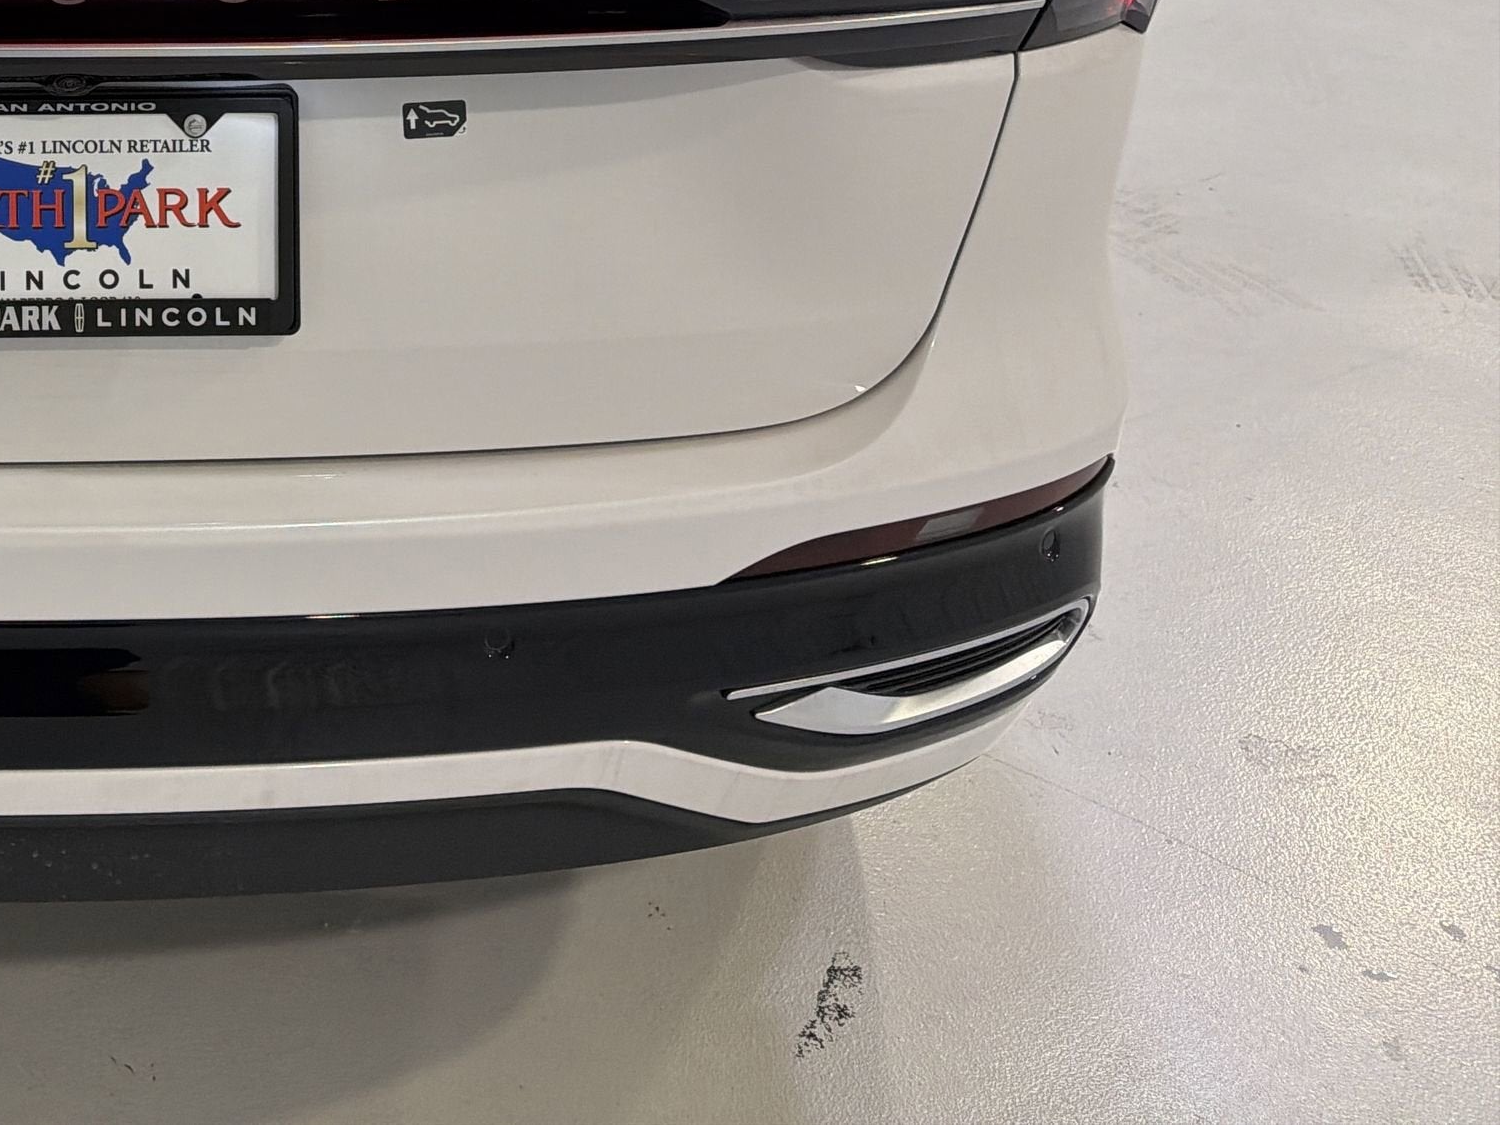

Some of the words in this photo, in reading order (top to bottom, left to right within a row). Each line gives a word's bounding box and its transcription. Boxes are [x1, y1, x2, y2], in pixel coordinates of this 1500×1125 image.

[36, 102, 157, 113] ANTONIO
[17, 140, 36, 155] #1
[40, 139, 123, 155] LINCOLN
[126, 138, 212, 154] RETAILER
[96, 187, 242, 228] PARK
[96, 306, 258, 328] LINCOLN
